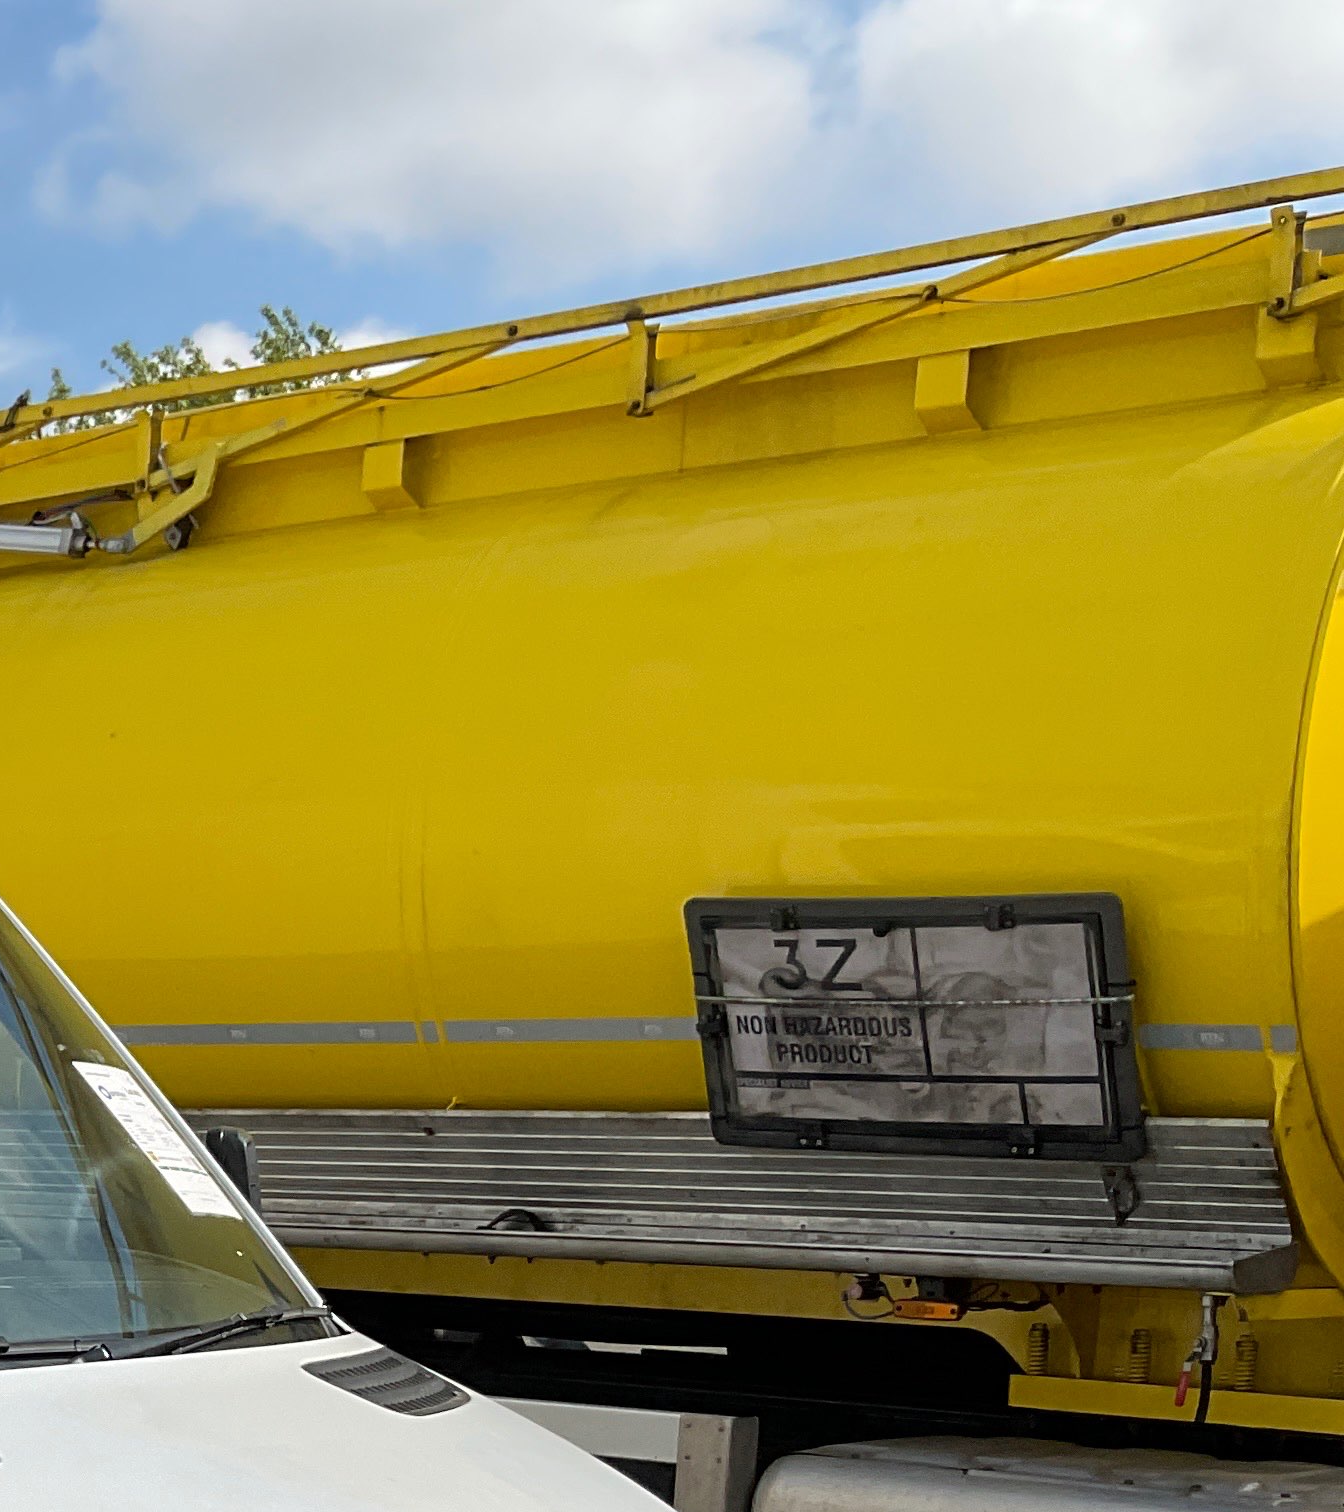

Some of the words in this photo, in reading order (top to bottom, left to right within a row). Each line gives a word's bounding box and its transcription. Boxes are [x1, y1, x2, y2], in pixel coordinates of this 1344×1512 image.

[736, 1015, 778, 1035] NON
[783, 1016, 913, 1037] HAZARDOUS
[776, 1043, 873, 1065] PRODUCT
